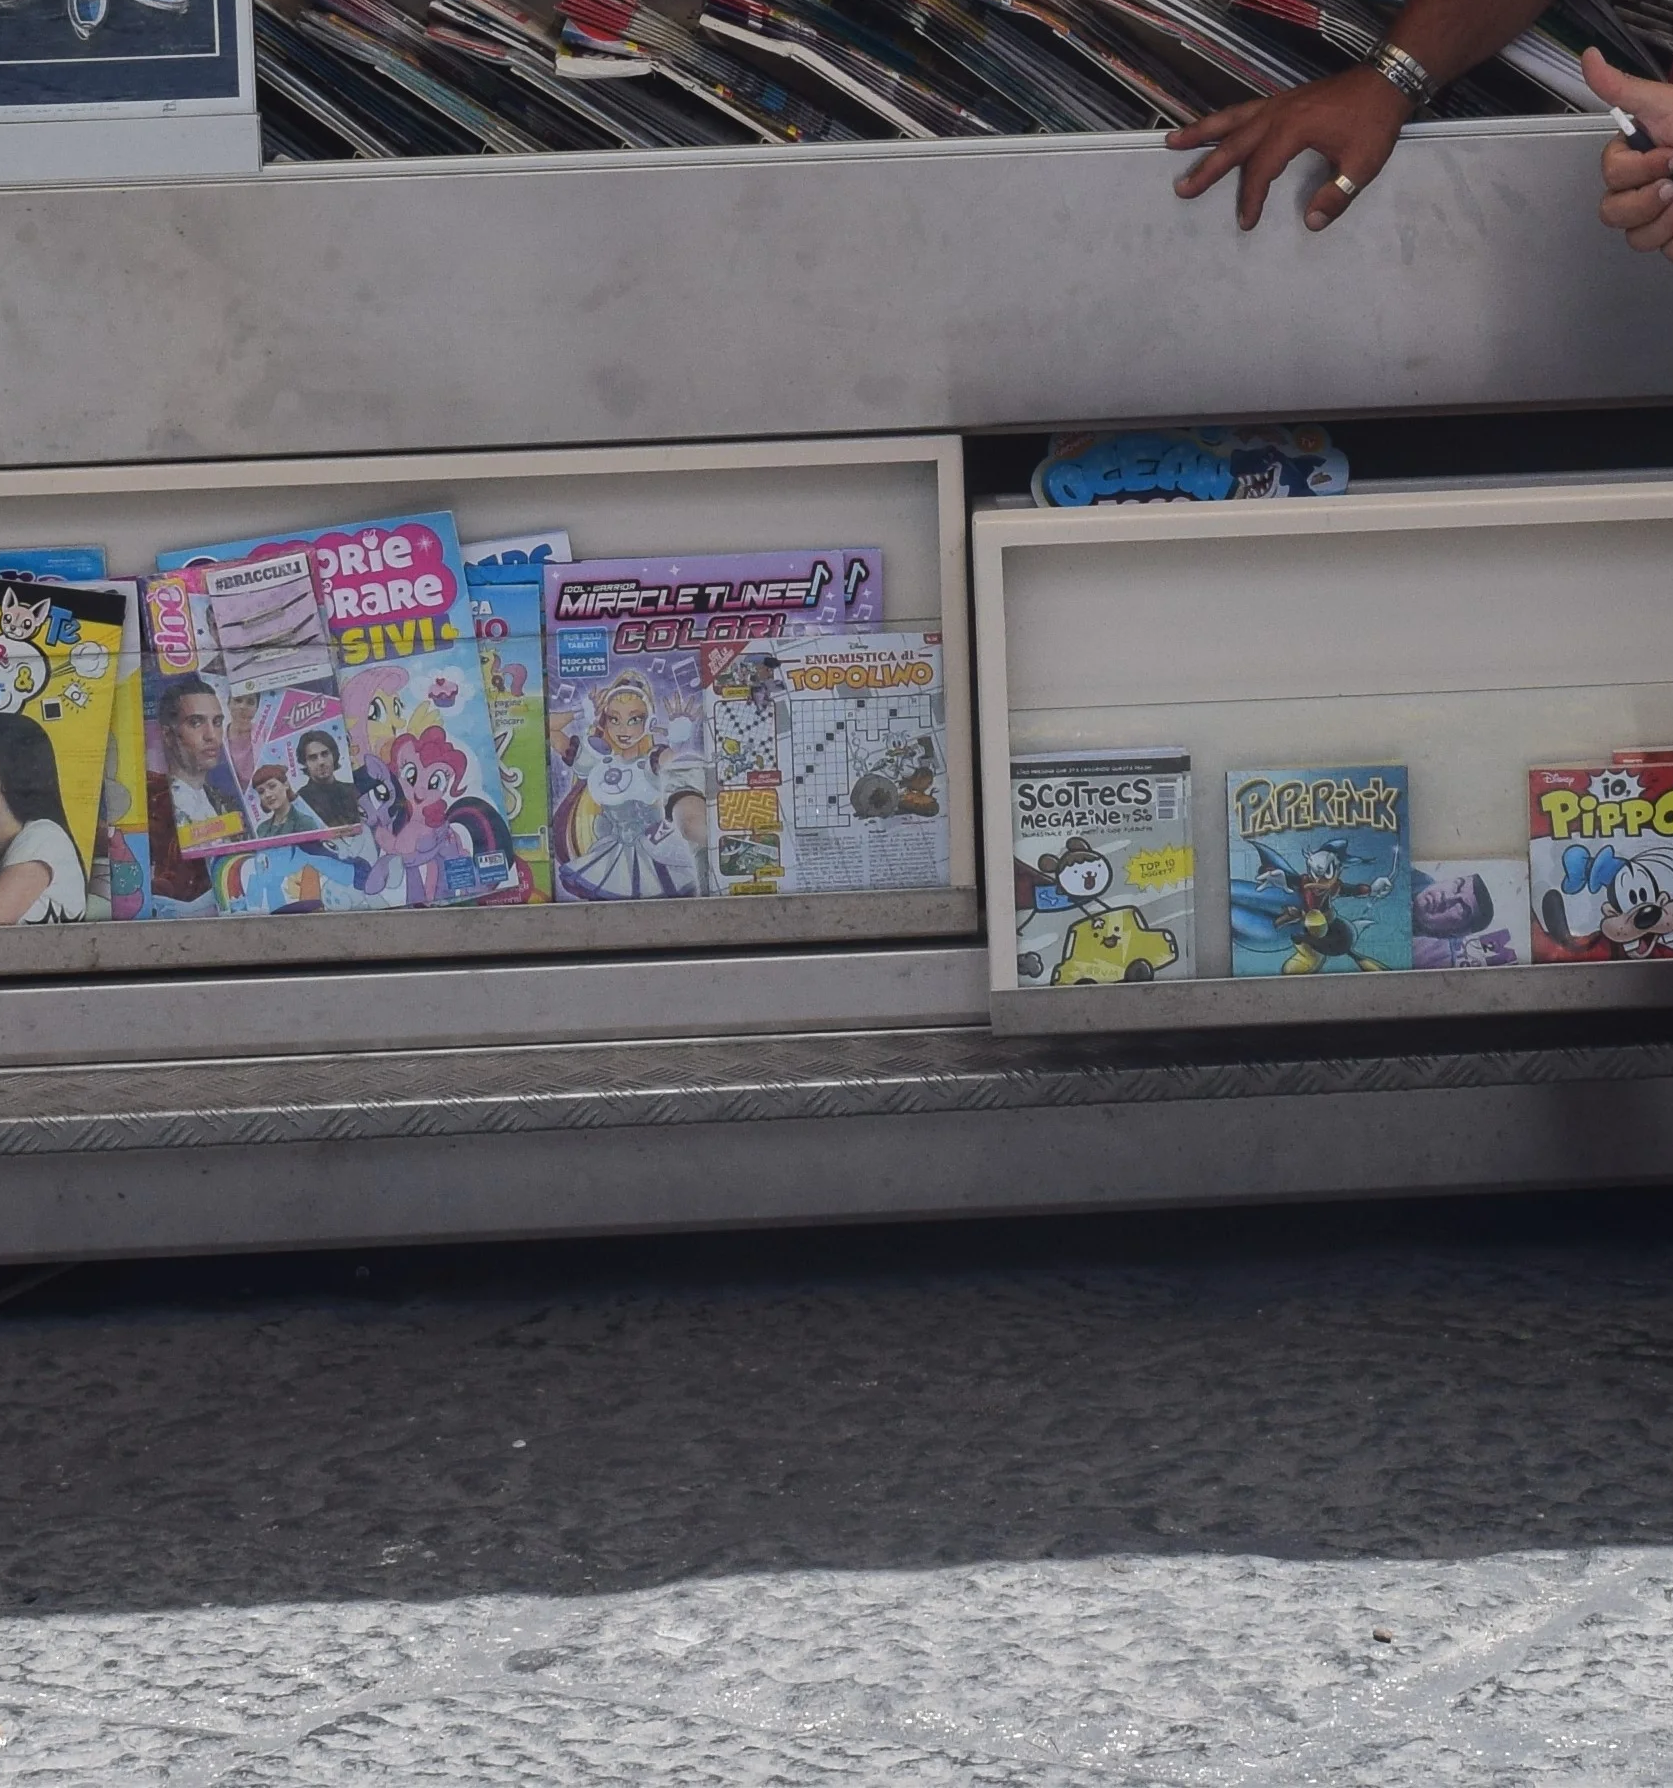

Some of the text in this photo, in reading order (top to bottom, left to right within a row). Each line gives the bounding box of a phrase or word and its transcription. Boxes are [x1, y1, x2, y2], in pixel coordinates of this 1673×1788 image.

[214, 560, 303, 593] #BRACCIALI
[559, 586, 699, 618] MIRACLE
[561, 664, 606, 673] PLAY PRESS
[804, 650, 916, 665] ENIGMISTICA di
[787, 661, 934, 693] TOPOLINO
[1139, 858, 1176, 872] TOP 10
